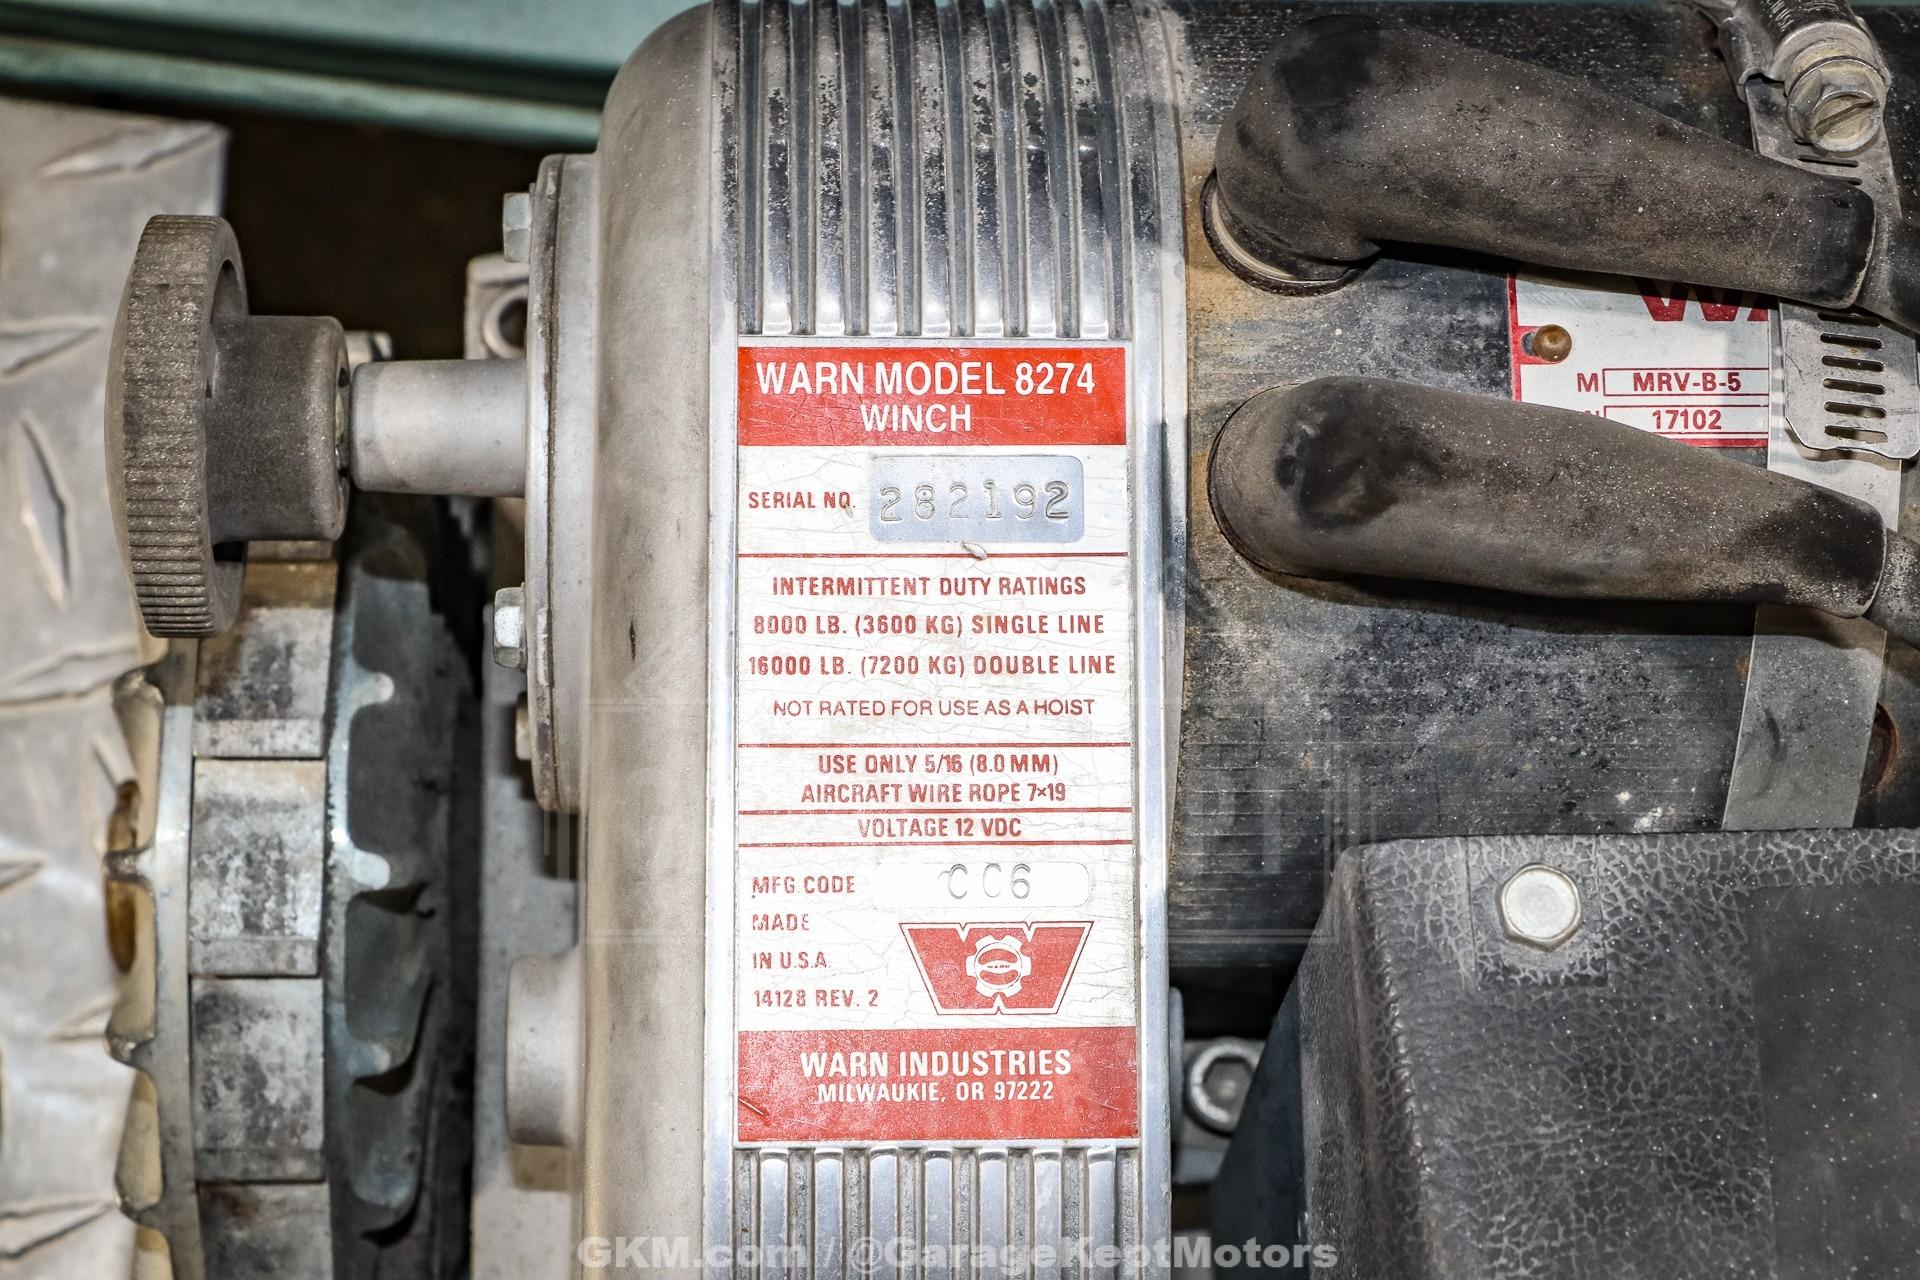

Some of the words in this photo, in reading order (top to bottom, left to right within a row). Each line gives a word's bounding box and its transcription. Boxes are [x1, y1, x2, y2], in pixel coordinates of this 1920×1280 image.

[755, 361, 864, 395] WARN
[875, 361, 1006, 395] MODEL
[1014, 361, 1095, 395] 8274
[1633, 371, 1742, 394] MRV-B-5
[861, 403, 972, 433] WINCH
[1652, 409, 1722, 431] 17102
[748, 491, 816, 509] SERIAL
[823, 491, 856, 509] NO.
[878, 479, 1070, 522] 282192
[772, 576, 930, 597] INTERMITTENT
[939, 576, 991, 596] DUTY
[999, 576, 1087, 596] RATINGS
[754, 615, 807, 635] 8000
[816, 615, 848, 635] LB.
[855, 615, 917, 638] (3600
[925, 615, 963, 638] KG)
[971, 614, 1049, 635] SINGLE
[1058, 614, 1105, 634] LINE
[748, 655, 811, 676] 16000
[820, 655, 852, 675] LB.
[861, 655, 919, 678] (7200
[928, 655, 965, 678] KG)
[973, 655, 1060, 676] DOUBLE
[1068, 655, 1116, 675] LINE
[773, 700, 811, 717] NOT
[819, 700, 886, 717] RATED
[890, 700, 933, 717] FOR
[939, 699, 979, 717] USE
[984, 699, 1011, 717] AS
[1015, 699, 1032, 716] A
[1034, 698, 1095, 716] HOIST
[818, 754, 856, 774] USE
[865, 754, 917, 774] ONLY
[924, 753, 963, 775] 5/16
[970, 753, 1005, 776] (8.0
[1010, 753, 1059, 776] MM)
[801, 783, 903, 804] AIRCRAFT
[908, 783, 963, 803] WIRE
[969, 783, 1021, 803] ROPE
[858, 818, 948, 838] VOLTAGE
[955, 817, 974, 837] 12
[980, 817, 1022, 837] VDC
[803, 875, 855, 894] CODE
[752, 913, 810, 931] MADE
[752, 951, 772, 969] IN
[779, 951, 832, 969] U.S.A.
[754, 988, 806, 1008] 14128
[815, 988, 860, 1008] REV.
[868, 988, 879, 1007] 2
[800, 1050, 889, 1079] WARN
[900, 1048, 1073, 1078] INDUSTRIES
[817, 1082, 945, 1104] MILWAUKIE,
[956, 1082, 985, 1102] OR
[994, 1080, 1055, 1101] 97222
